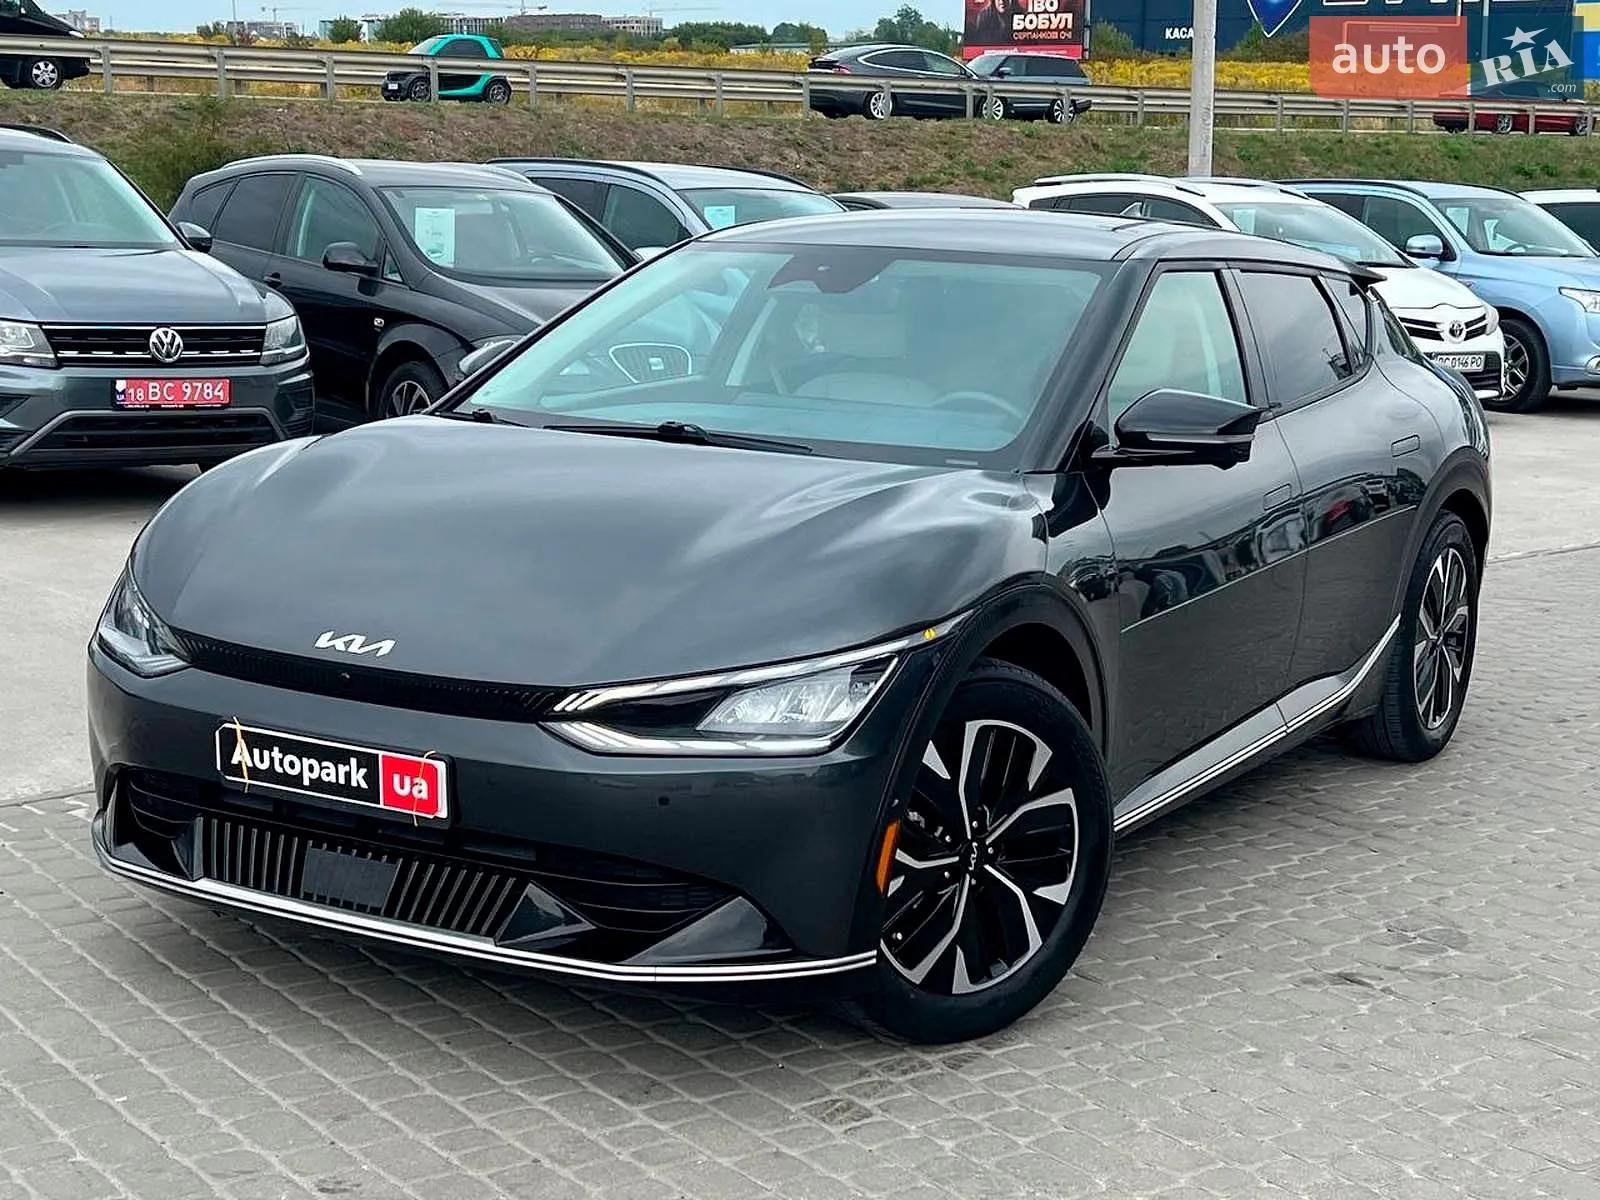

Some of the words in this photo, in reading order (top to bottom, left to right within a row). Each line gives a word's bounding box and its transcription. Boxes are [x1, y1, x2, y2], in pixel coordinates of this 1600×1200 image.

[1012, 13, 1073, 30] БОБУЛ
[128, 387, 145, 402] 18
[148, 382, 175, 401] BC
[182, 382, 225, 401] 9784
[231, 738, 369, 789] Autopark
[393, 772, 429, 800] ua
